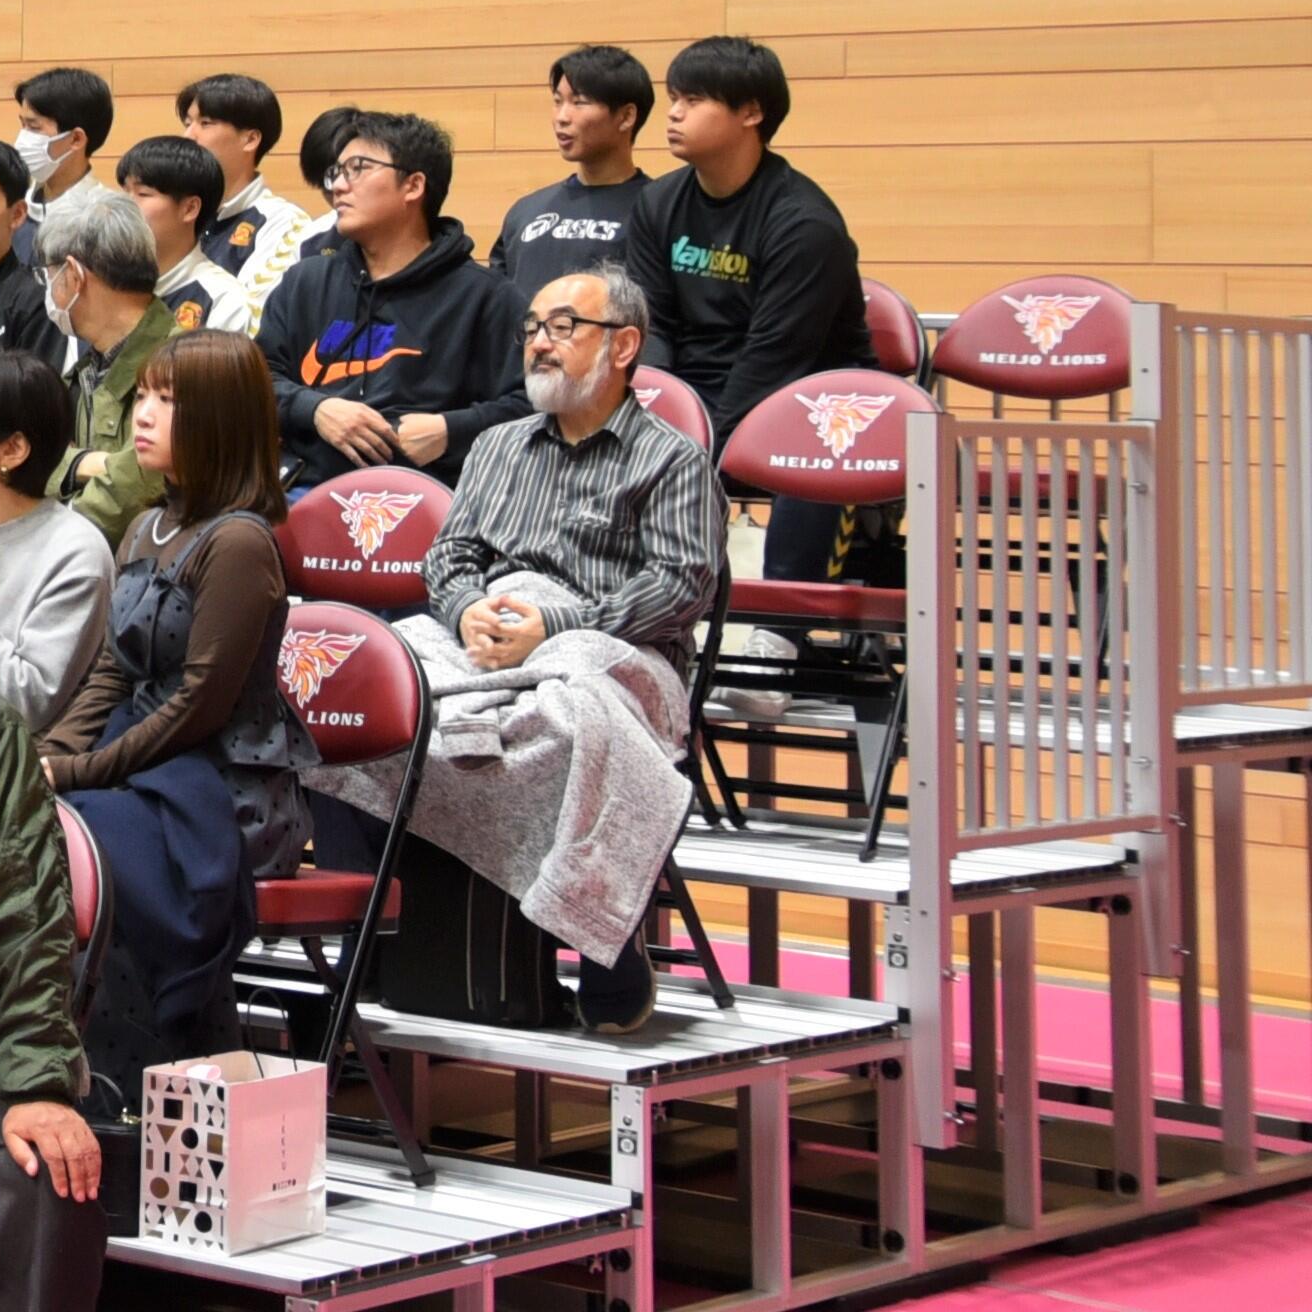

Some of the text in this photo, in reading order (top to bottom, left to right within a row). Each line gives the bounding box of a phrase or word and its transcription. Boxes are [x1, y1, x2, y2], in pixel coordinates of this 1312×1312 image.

[552, 218, 623, 241] asics
[979, 352, 1107, 366] MEIJO LIONS
[769, 455, 900, 472] MEIJO LIONS
[303, 556, 423, 574] MEIJO LIONS
[306, 711, 365, 726] LIONS
